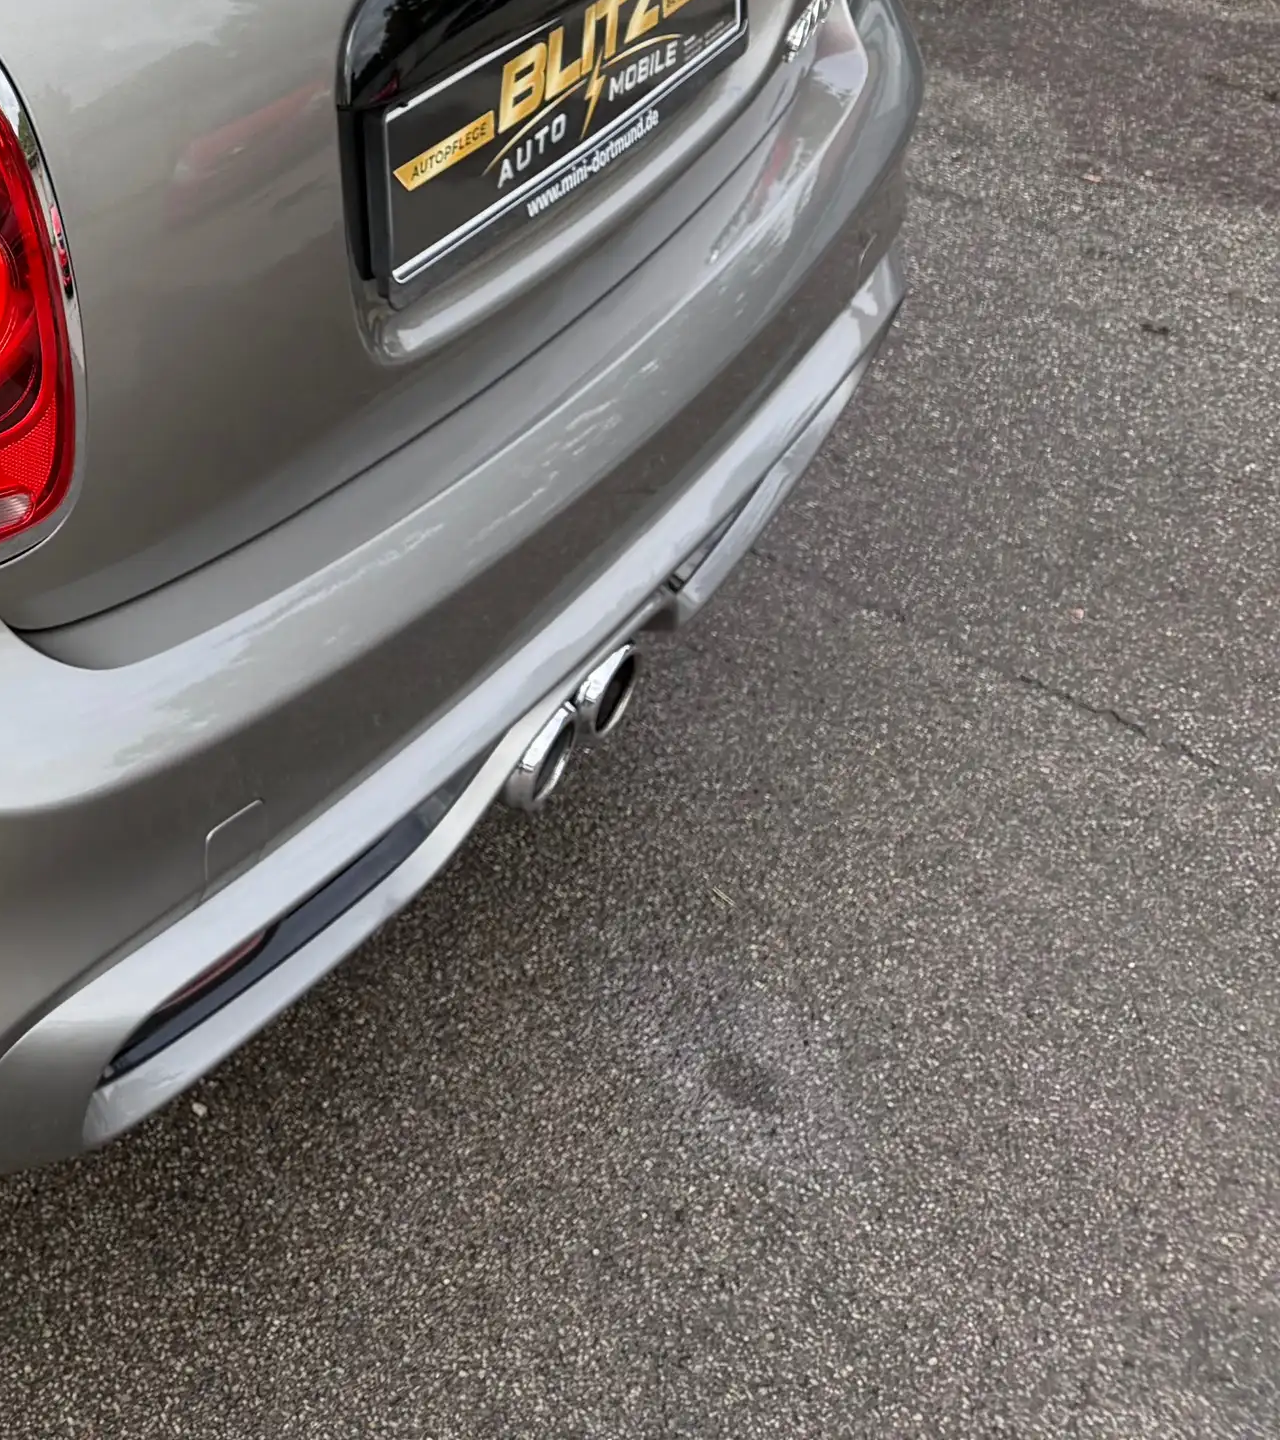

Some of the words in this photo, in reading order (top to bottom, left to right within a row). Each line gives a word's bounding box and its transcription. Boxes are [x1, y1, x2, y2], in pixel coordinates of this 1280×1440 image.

[409, 120, 489, 182] AUTOPFLEGE
[498, 113, 568, 190] AUTO
[608, 39, 679, 102] MOBILE
[526, 107, 660, 218] www.mini-dortmund.de
